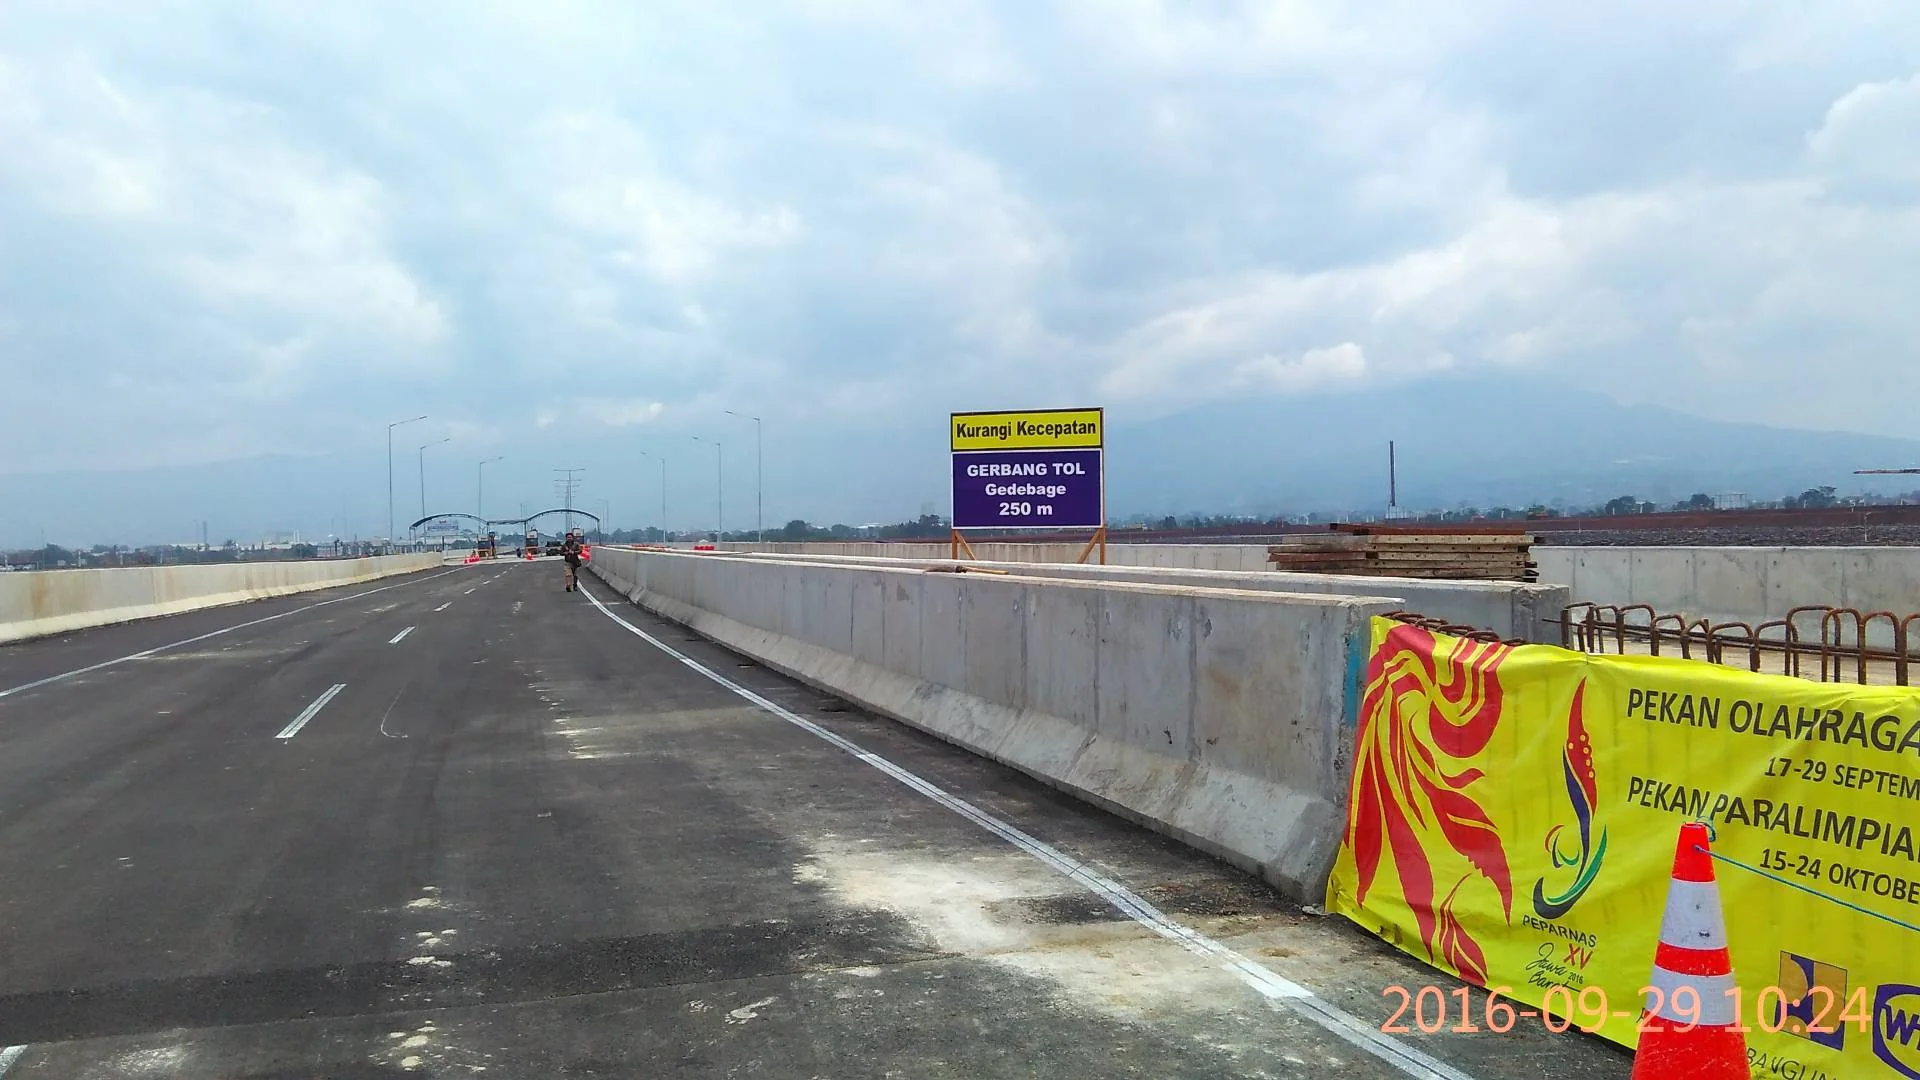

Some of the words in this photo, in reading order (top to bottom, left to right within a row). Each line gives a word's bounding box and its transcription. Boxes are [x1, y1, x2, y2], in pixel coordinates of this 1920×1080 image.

[957, 421, 1012, 440] Kurangi
[1017, 420, 1096, 438] Kecepatan
[967, 463, 1048, 477] GERBANG
[1052, 462, 1086, 475] TOL
[985, 483, 1067, 498] Gedebage
[999, 502, 1031, 516] 250
[1037, 504, 1053, 516] m
[1627, 688, 1721, 729] PEKAN
[1729, 700, 1920, 758] OLAHRAGA
[1764, 757, 1827, 783] 17-29
[1833, 764, 1920, 801] SEPTEM
[1627, 776, 1711, 818] PEKAN
[1709, 793, 1920, 863] PARALIMPIA
[1759, 848, 1822, 880] 15-24
[1829, 863, 1920, 905] OKTOBE
[1522, 915, 1597, 948] PEPARNAS
[1525, 942, 1567, 976] Jawa
[1568, 972, 1584, 984] 2016
[1563, 943, 1594, 970] XV
